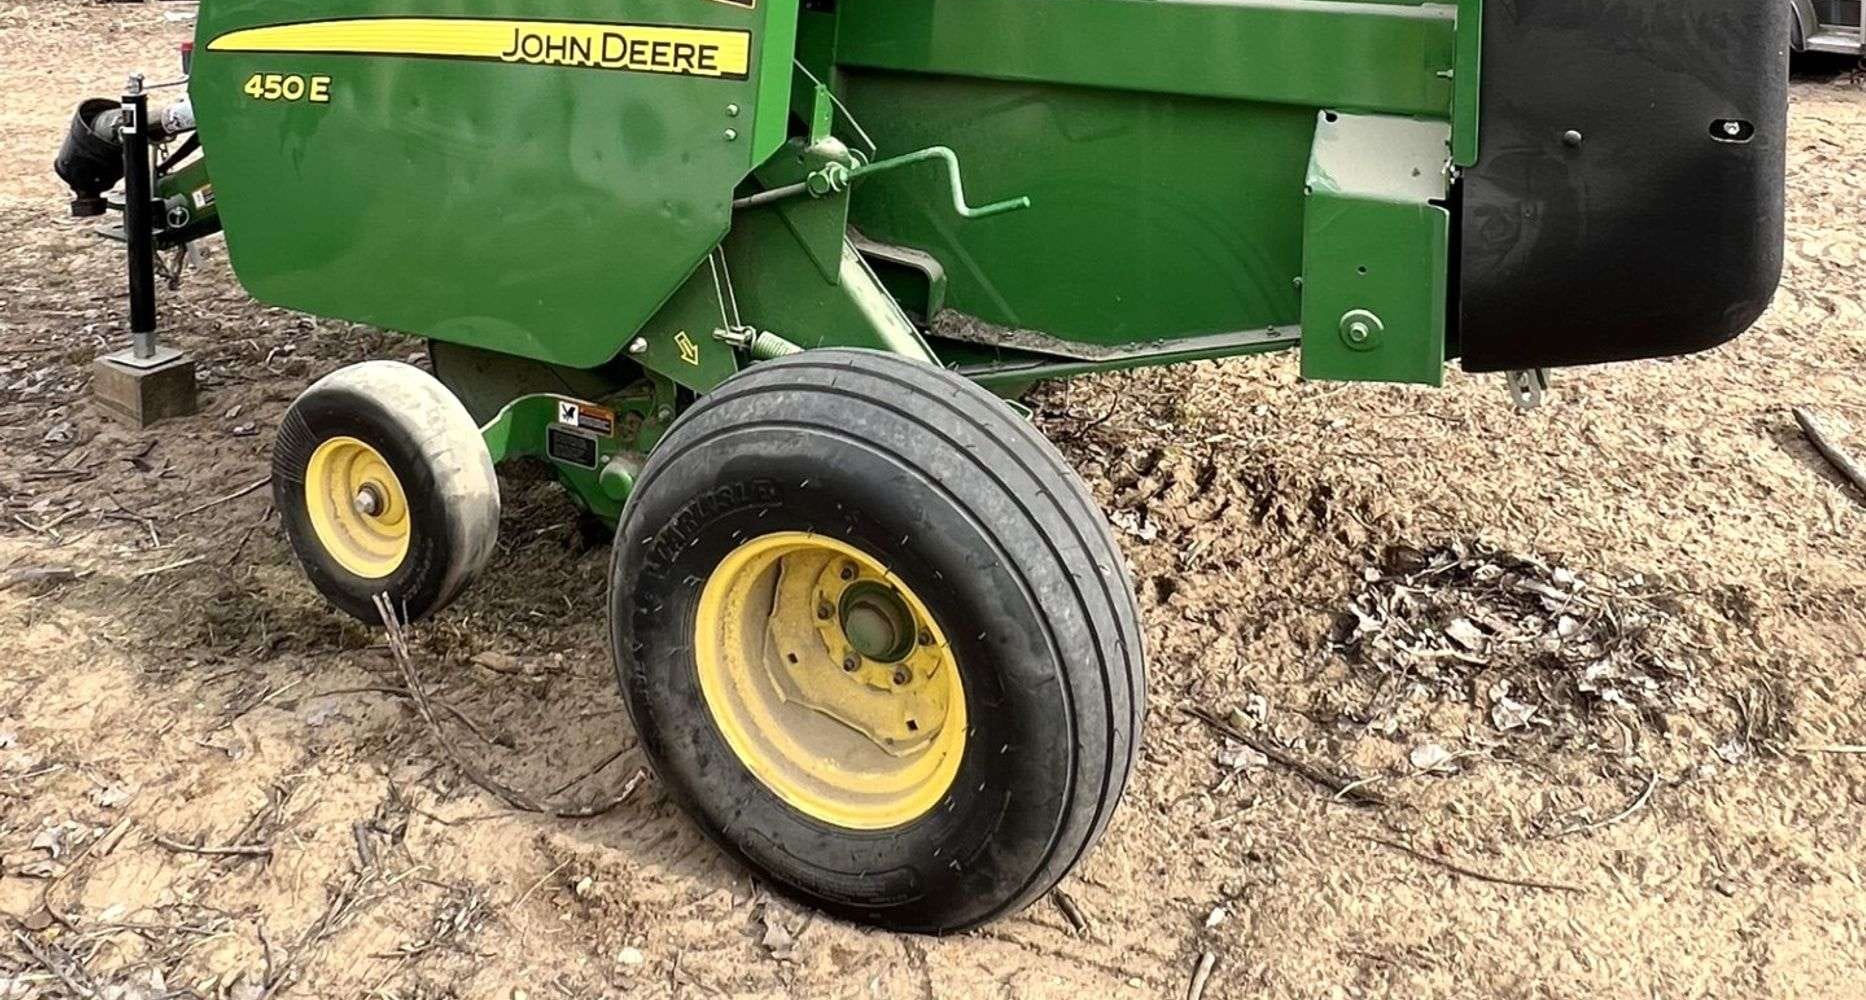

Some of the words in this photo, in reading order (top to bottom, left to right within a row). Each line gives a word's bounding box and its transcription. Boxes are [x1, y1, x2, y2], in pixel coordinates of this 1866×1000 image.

[502, 27, 592, 62] JOHN
[600, 31, 719, 71] DEERE
[243, 73, 305, 101] 450
[309, 75, 331, 102] E
